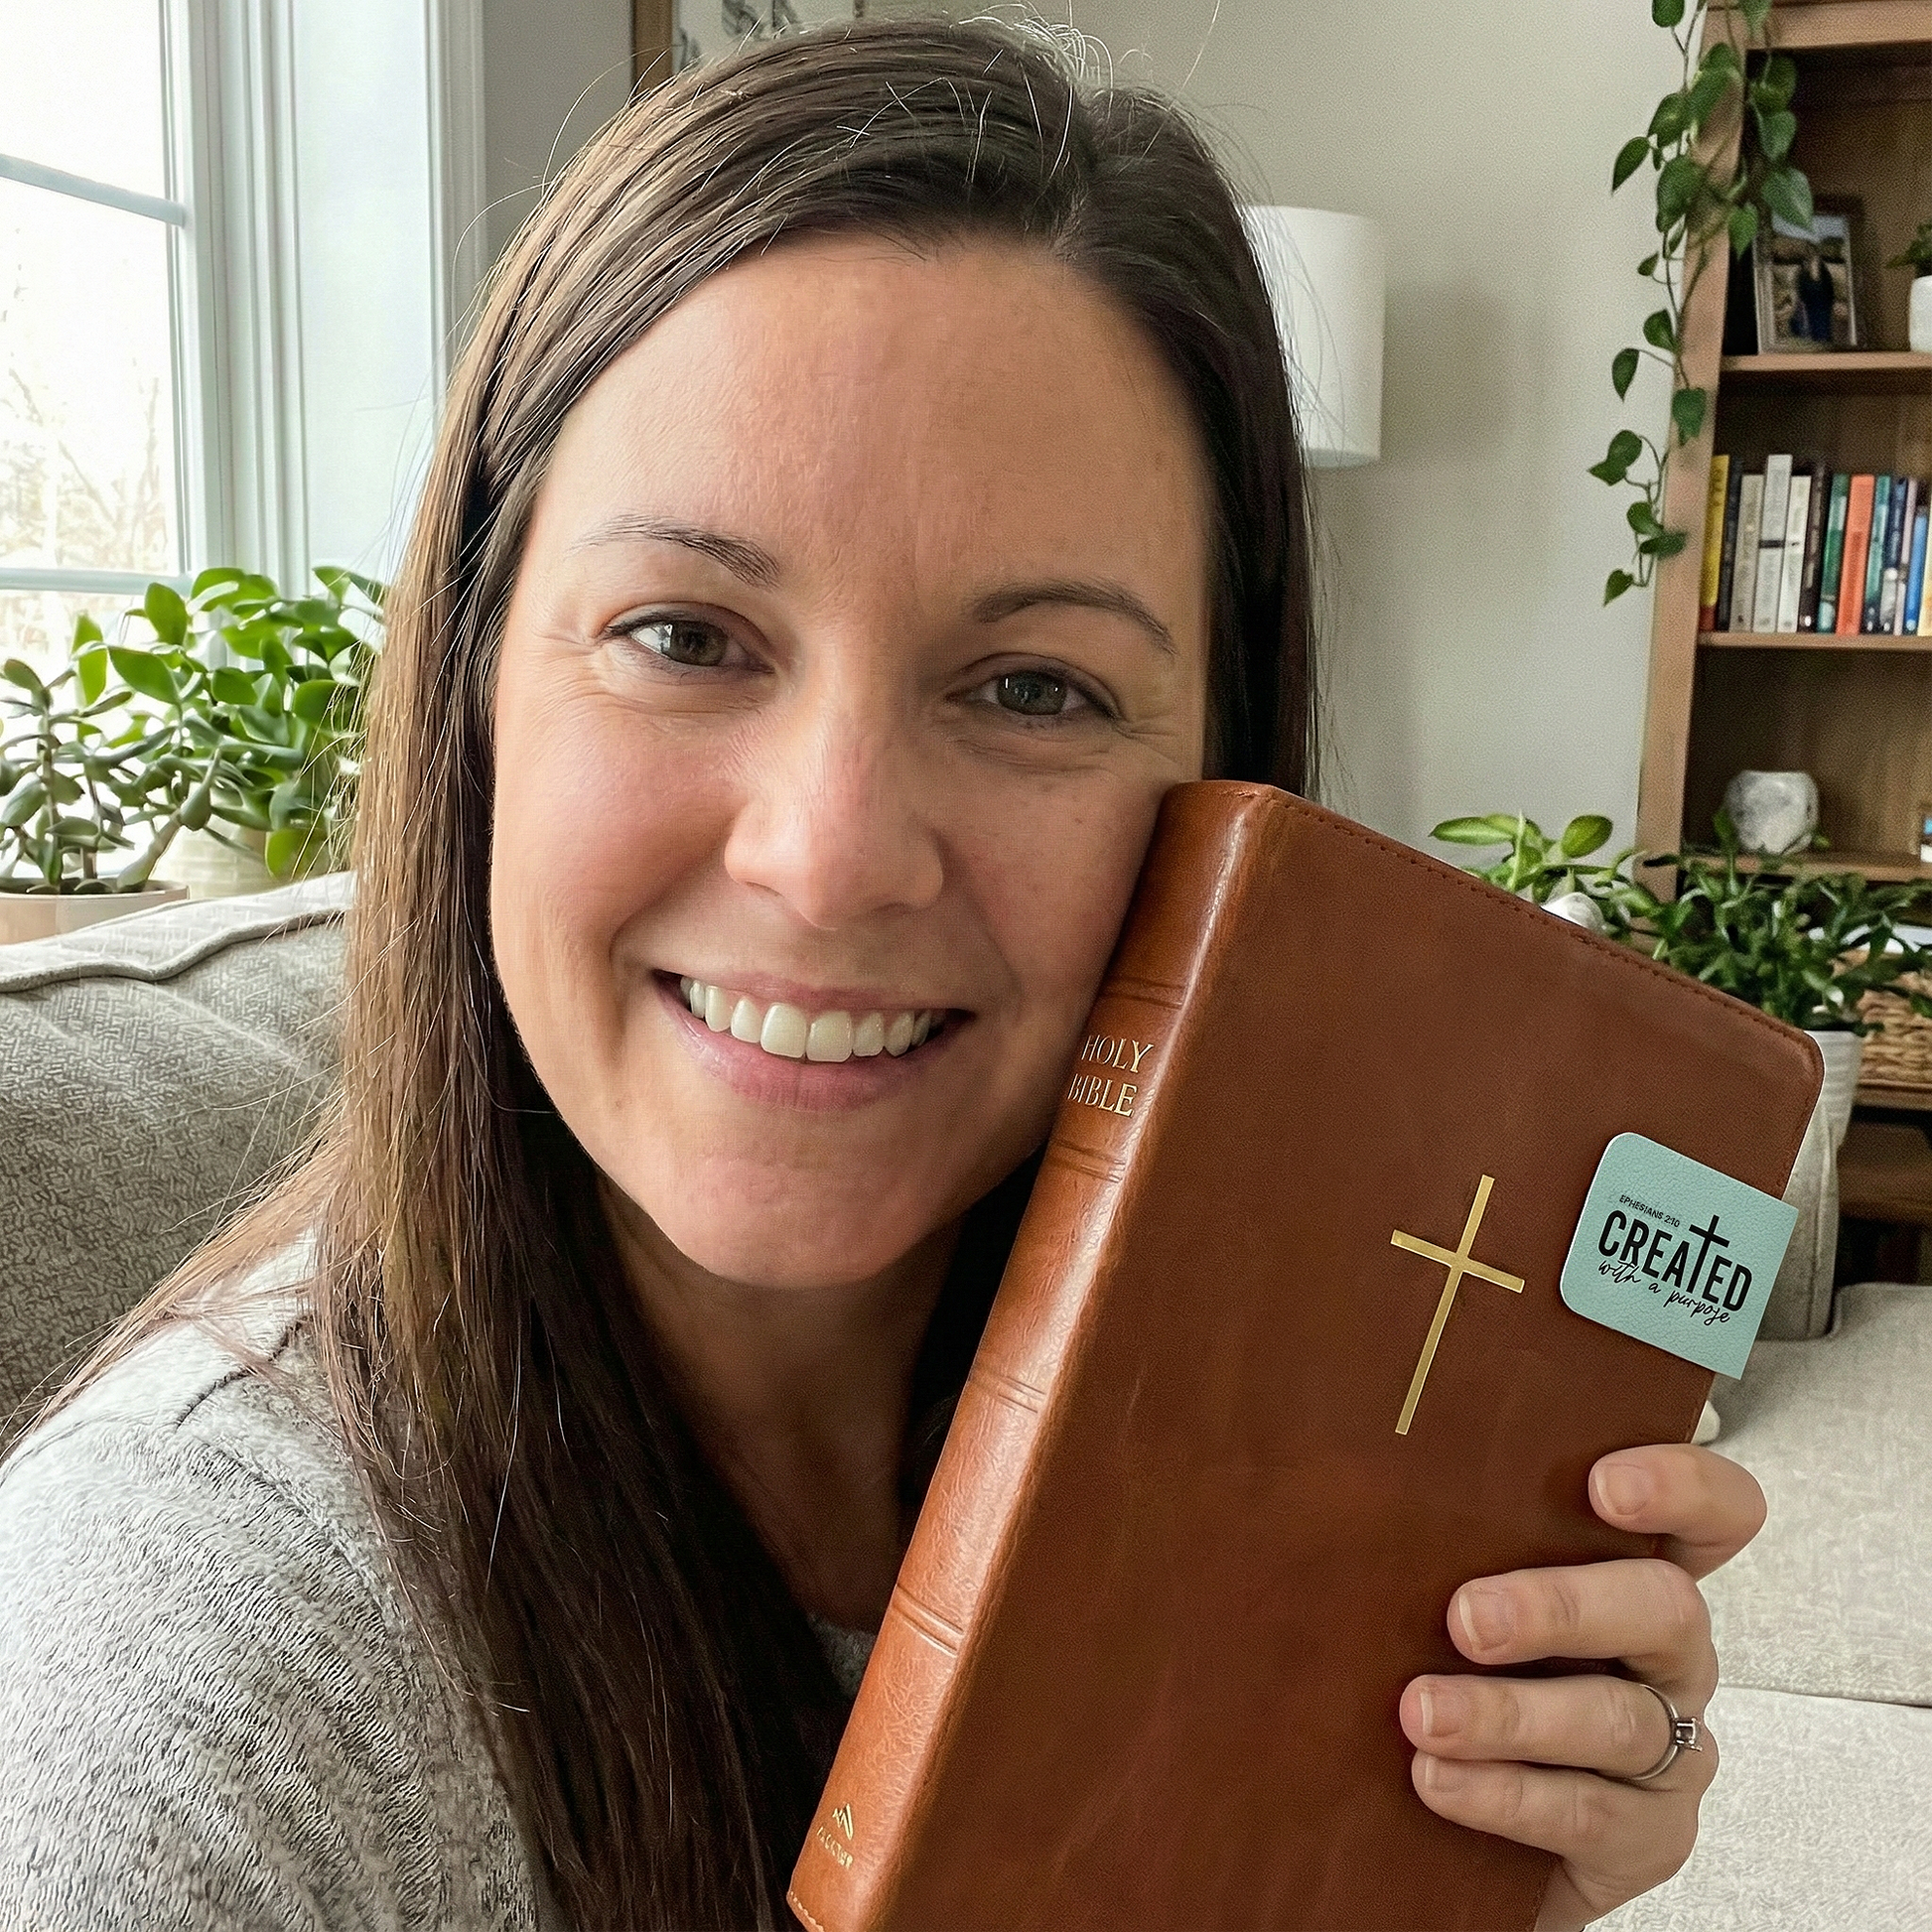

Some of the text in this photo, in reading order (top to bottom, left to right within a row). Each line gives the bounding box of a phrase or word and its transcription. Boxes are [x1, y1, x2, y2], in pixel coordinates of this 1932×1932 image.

[1080, 1035, 1155, 1073] HOLY
[1067, 1073, 1138, 1118] BIBLE
[1619, 1194, 1681, 1228] EPHESIANS 2:10
[1598, 1209, 1753, 1311] CREATED
[1597, 1259, 1730, 1326] with a purpose
